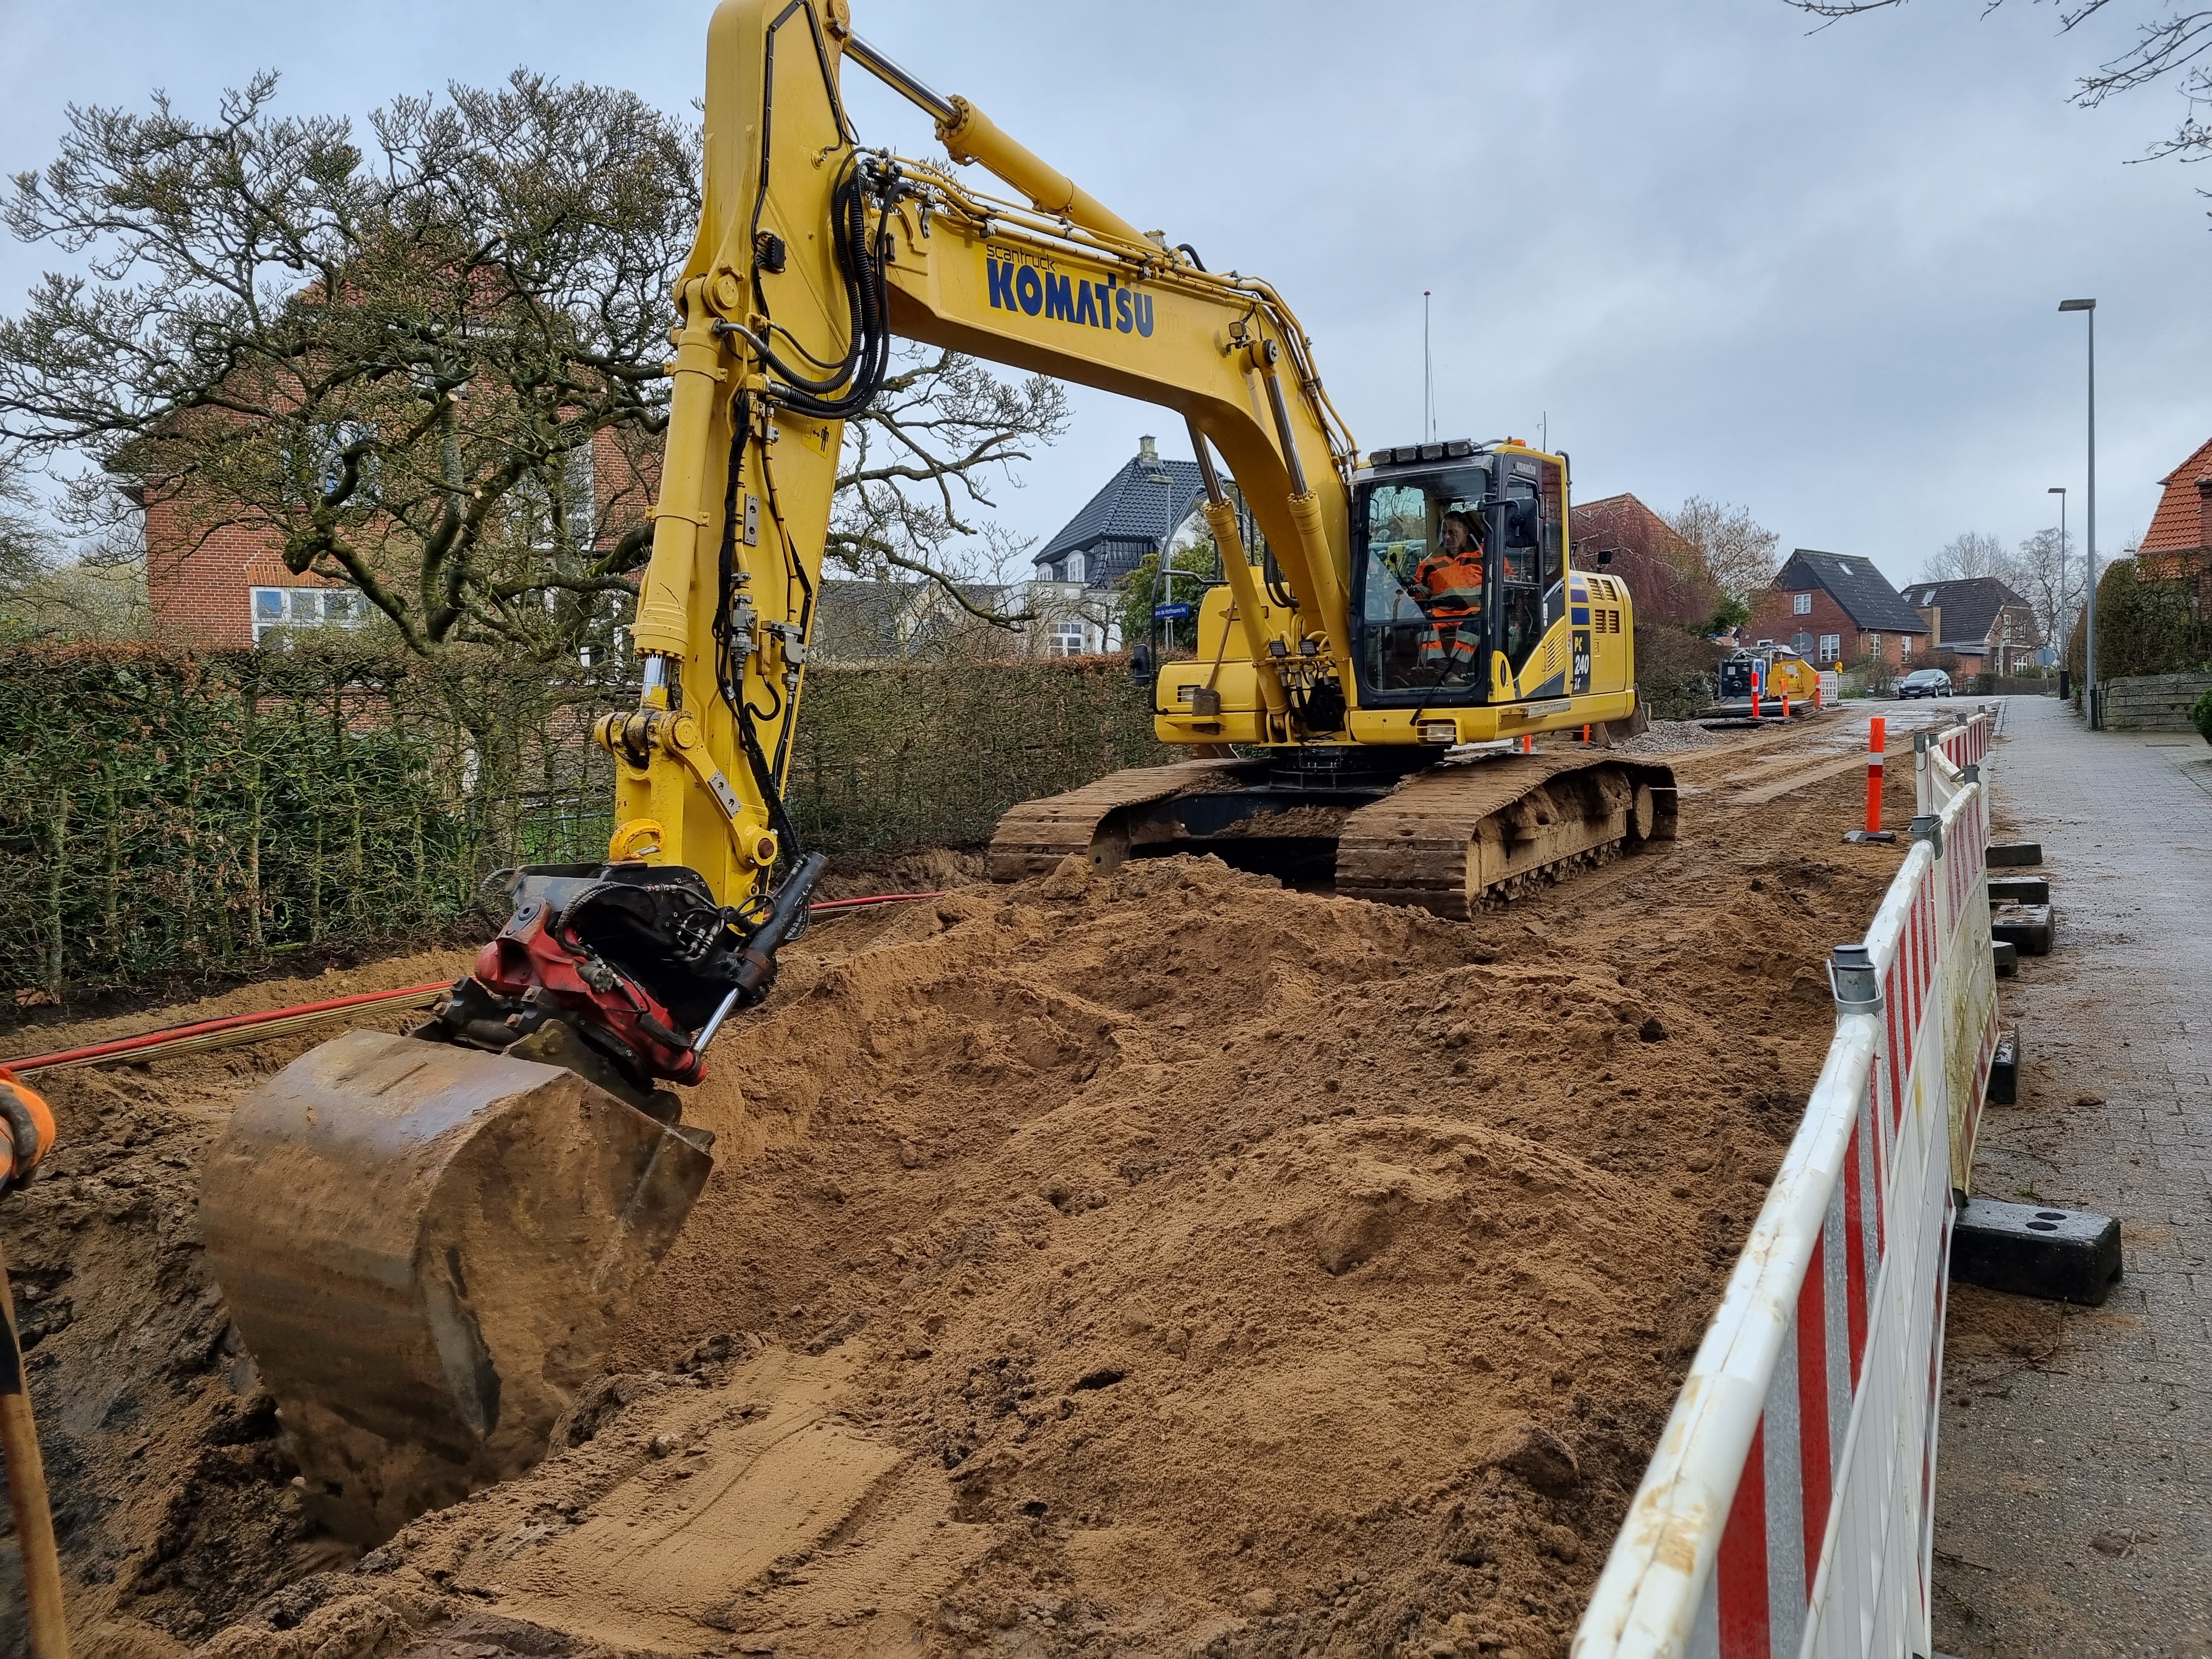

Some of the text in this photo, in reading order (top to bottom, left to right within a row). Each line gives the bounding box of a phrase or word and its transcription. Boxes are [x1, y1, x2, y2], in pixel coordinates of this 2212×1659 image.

[986, 244, 1056, 272] scantruck
[986, 257, 1154, 338] KOMATSU
[1516, 461, 1536, 476] KOMATSU
[1575, 636, 1583, 652] PC
[1575, 654, 1589, 675] 240
